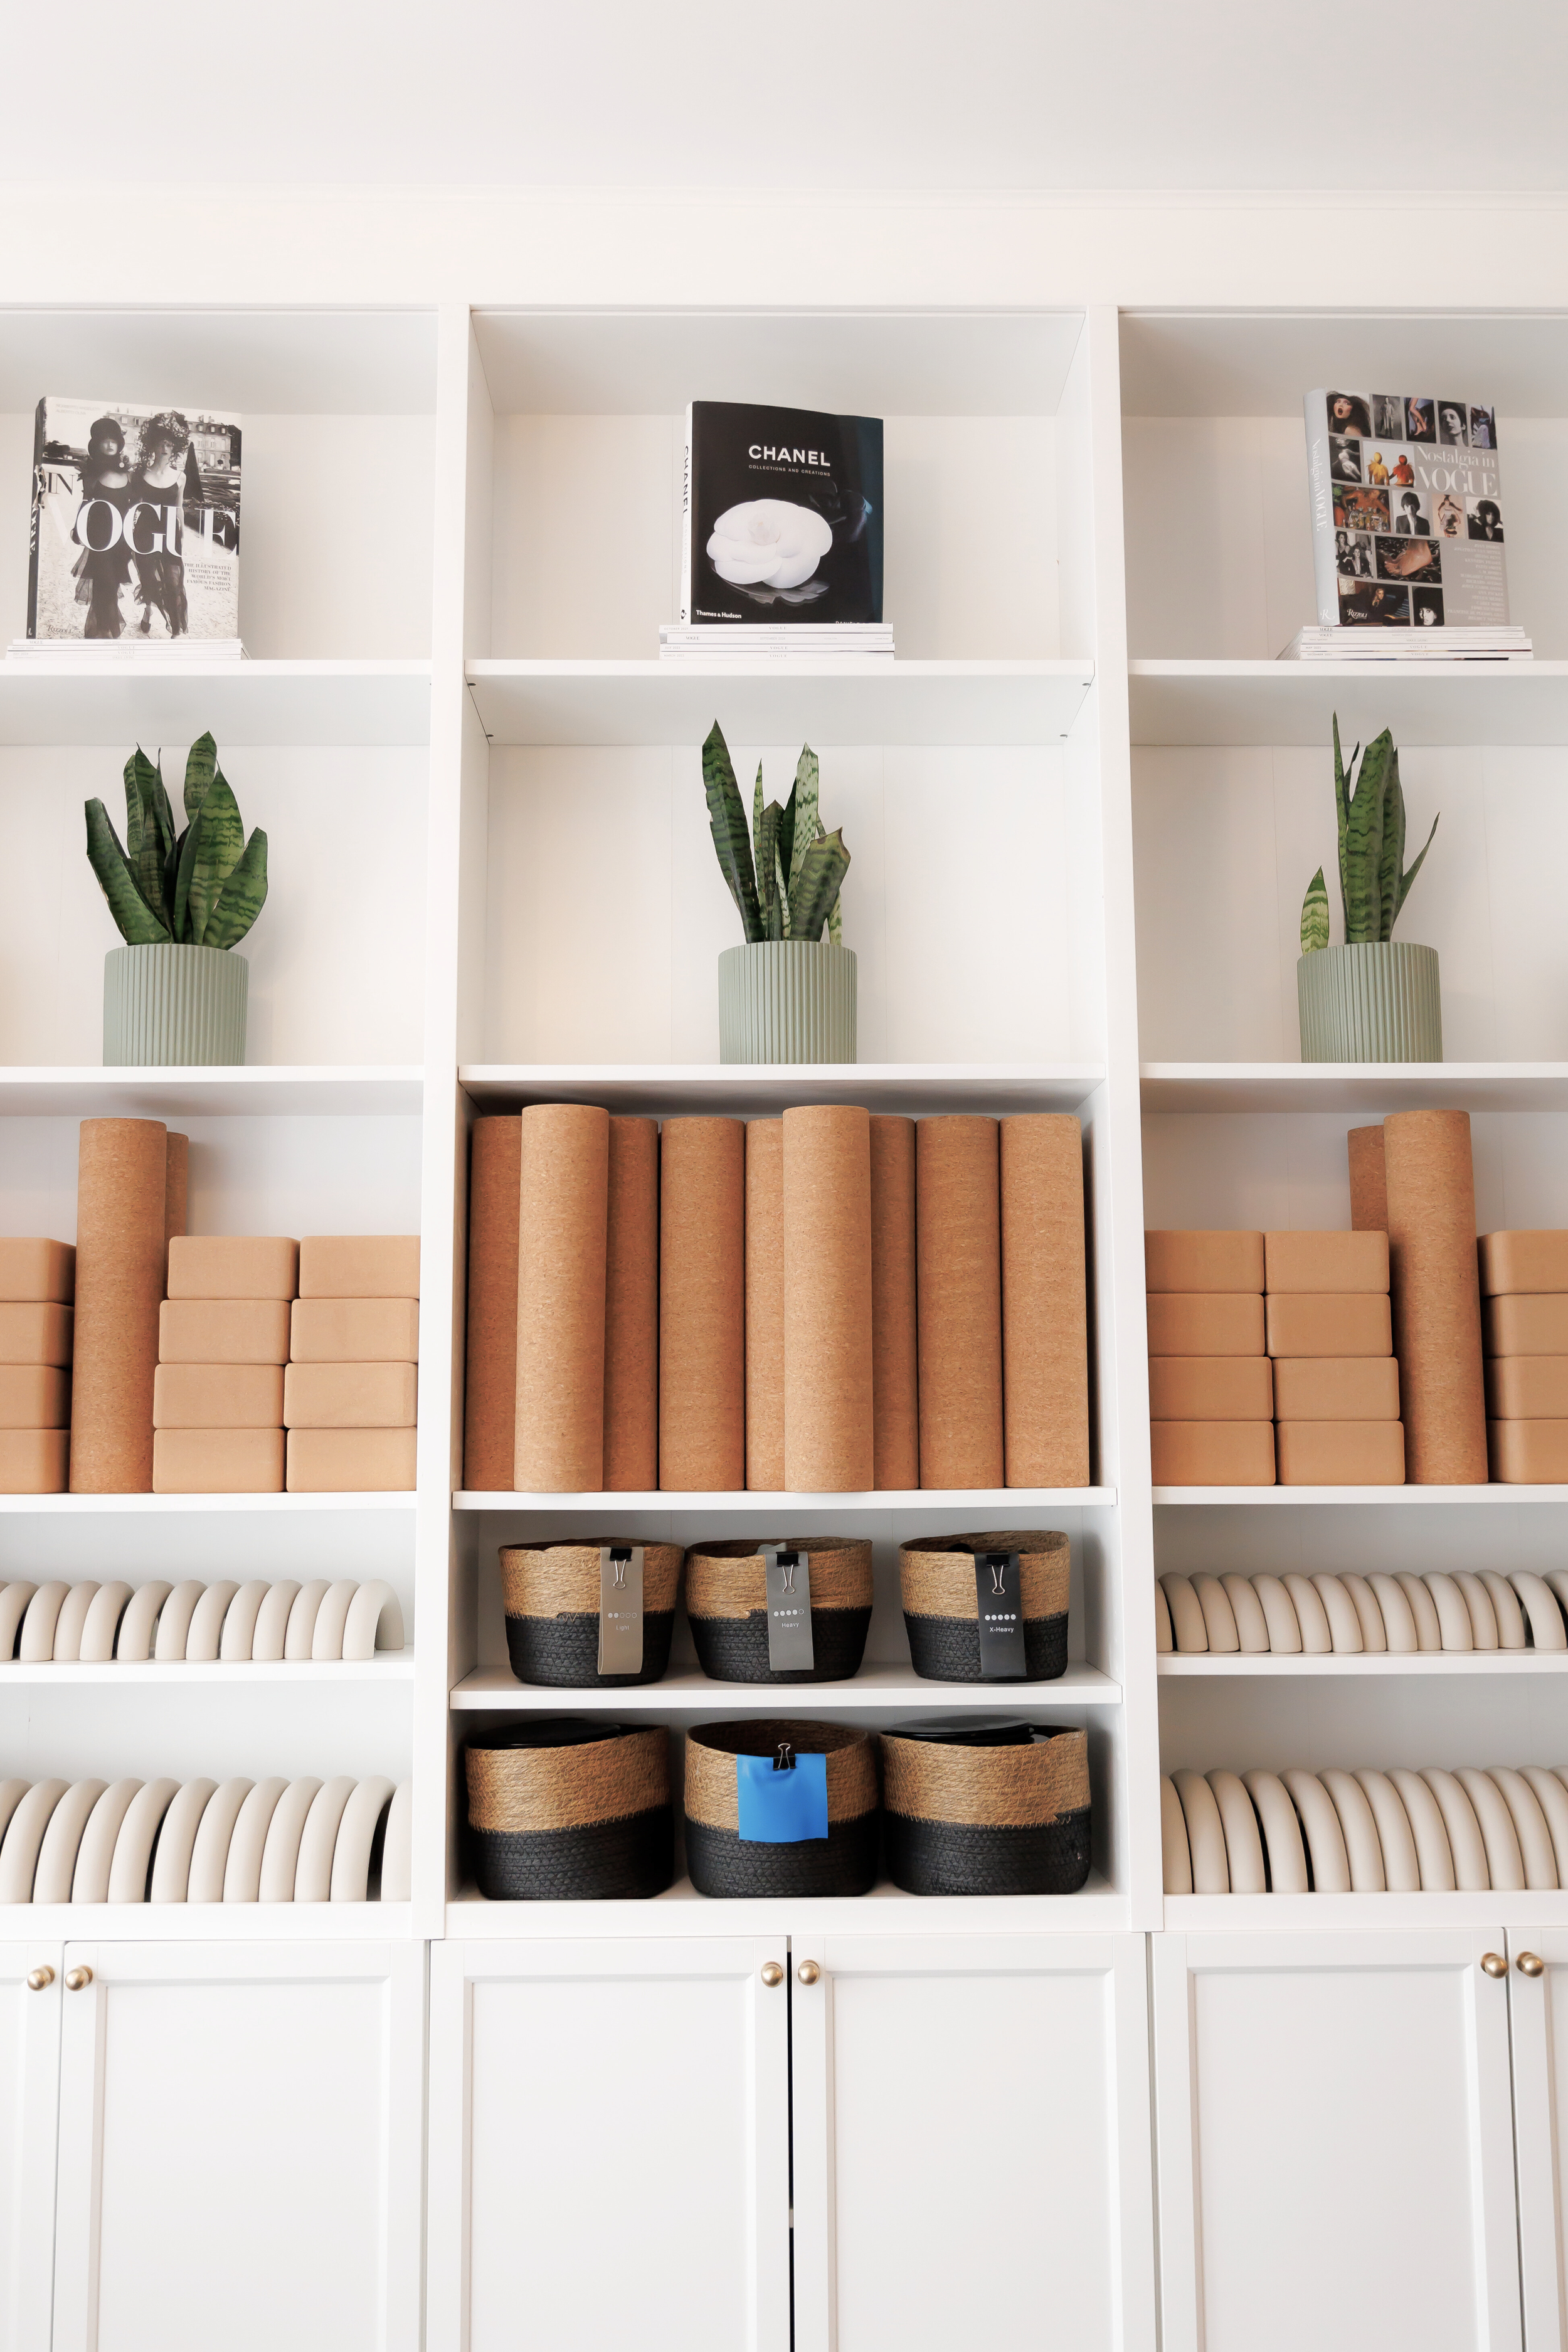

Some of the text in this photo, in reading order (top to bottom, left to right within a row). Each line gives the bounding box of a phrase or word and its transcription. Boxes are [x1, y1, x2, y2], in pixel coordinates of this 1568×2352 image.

[749, 445, 831, 467] CHANEL
[1416, 445, 1495, 471] Nostalgia in
[748, 464, 787, 472] COLLECTIONS
[800, 469, 831, 477] CREATIONS
[1417, 465, 1498, 497] VOGUE
[46, 471, 76, 495] IN
[1314, 489, 1328, 532] VOGUE
[46, 495, 238, 558] VOGUE
[1320, 608, 1335, 620] R
[1347, 608, 1368, 620] RIZZOLI
